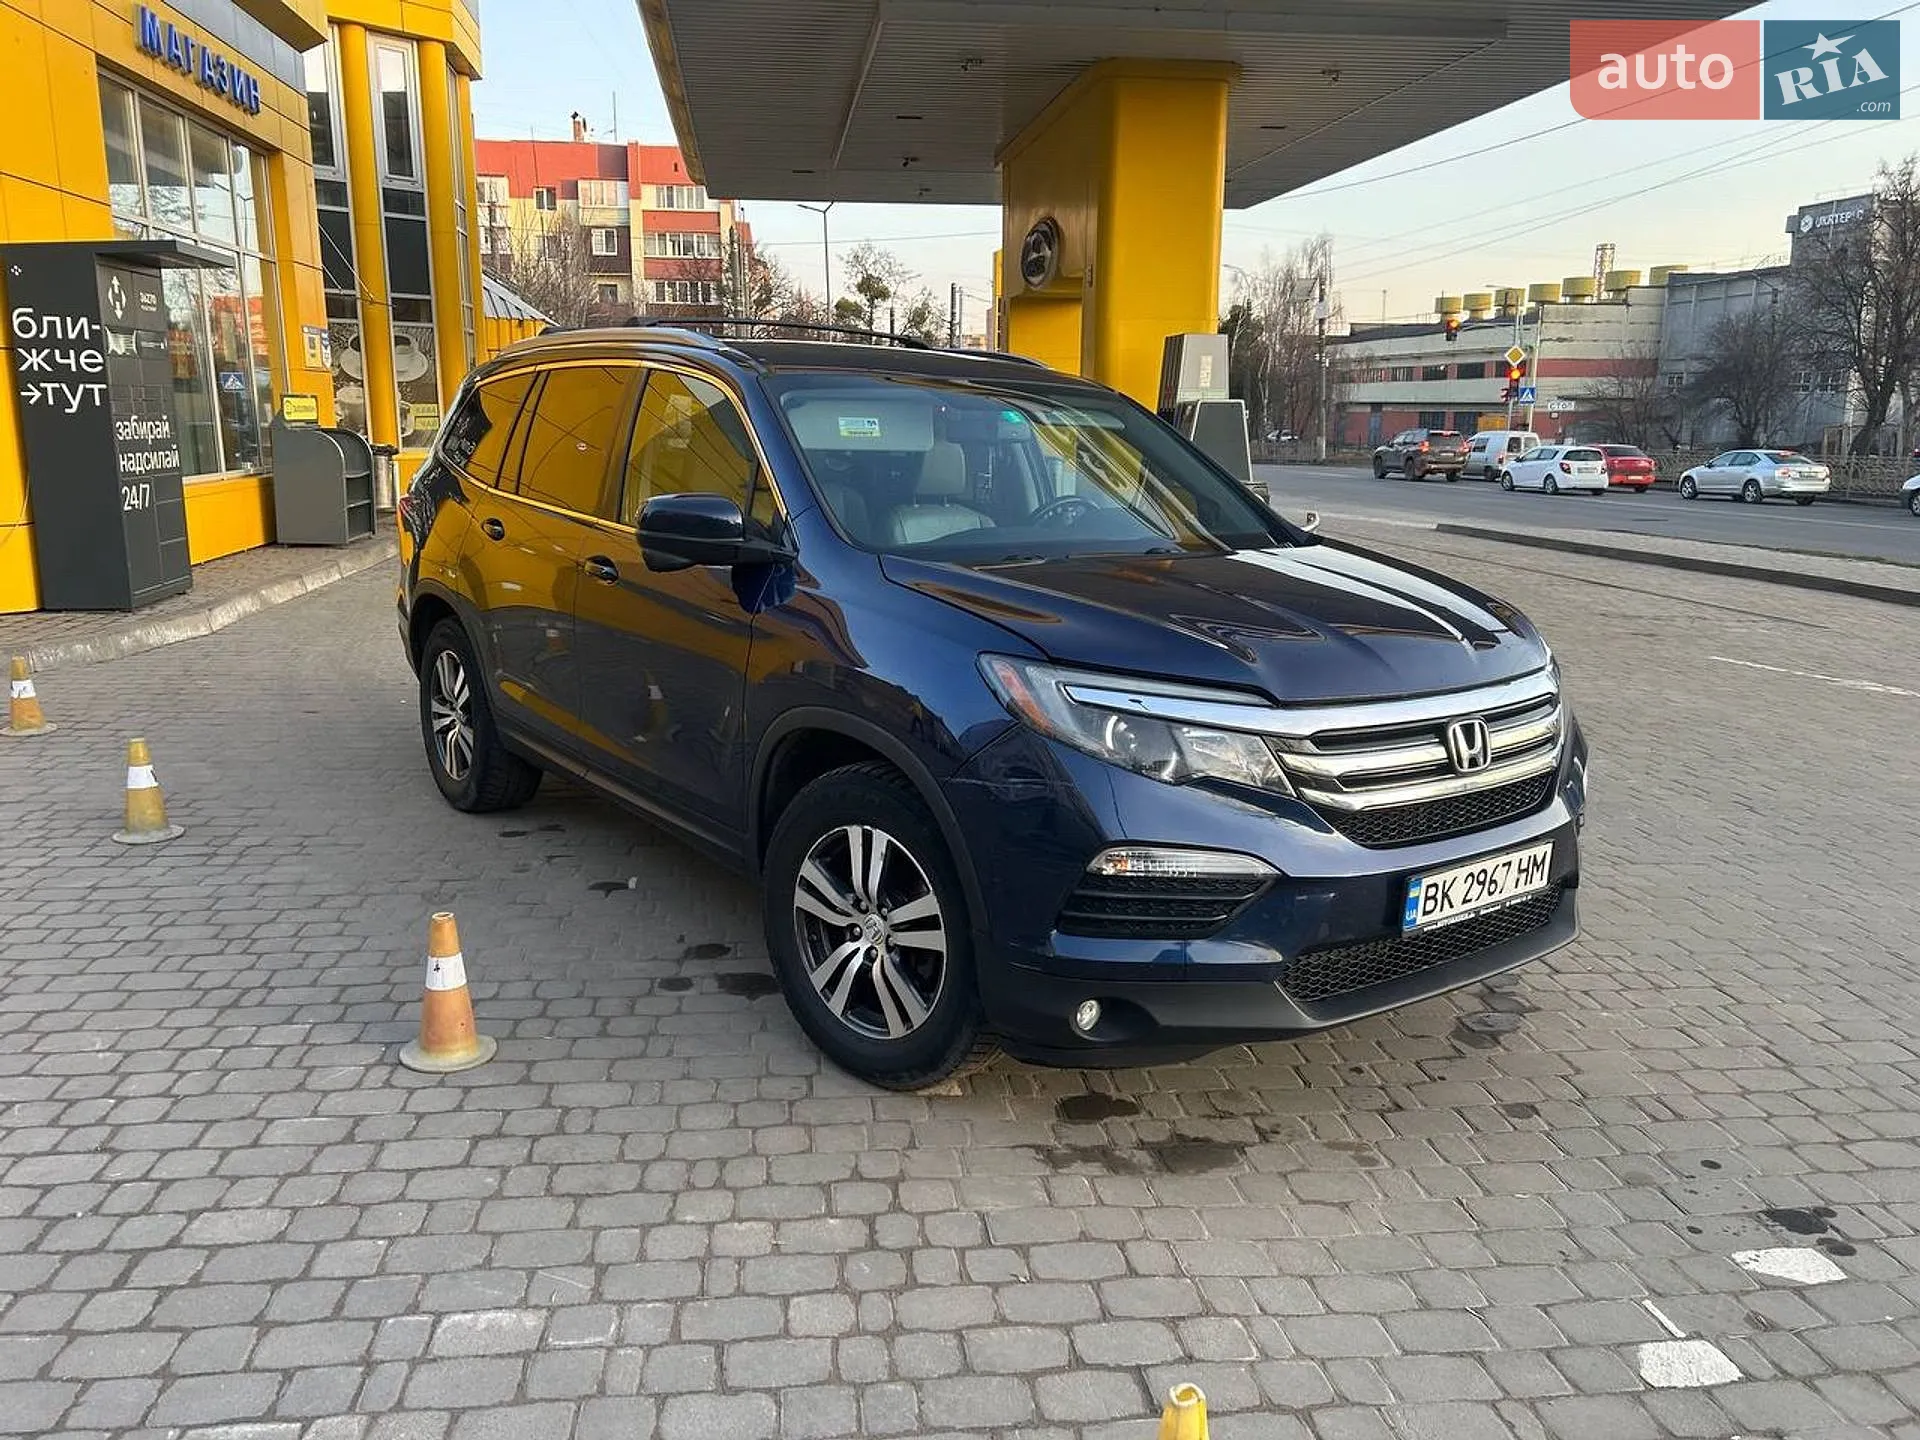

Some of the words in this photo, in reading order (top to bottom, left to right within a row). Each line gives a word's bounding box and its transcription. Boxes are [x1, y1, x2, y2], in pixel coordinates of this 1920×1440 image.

[138, 5, 260, 116] МАГАЗИН
[12, 307, 101, 340] бли-
[17, 348, 104, 373] жче
[40, 382, 107, 414] тут
[115, 415, 171, 445] забирай
[119, 444, 180, 475] надсилай
[121, 483, 150, 511] 24/7
[1422, 876, 1458, 917] BK
[1461, 861, 1511, 905] 2967
[1514, 850, 1548, 889] HM
